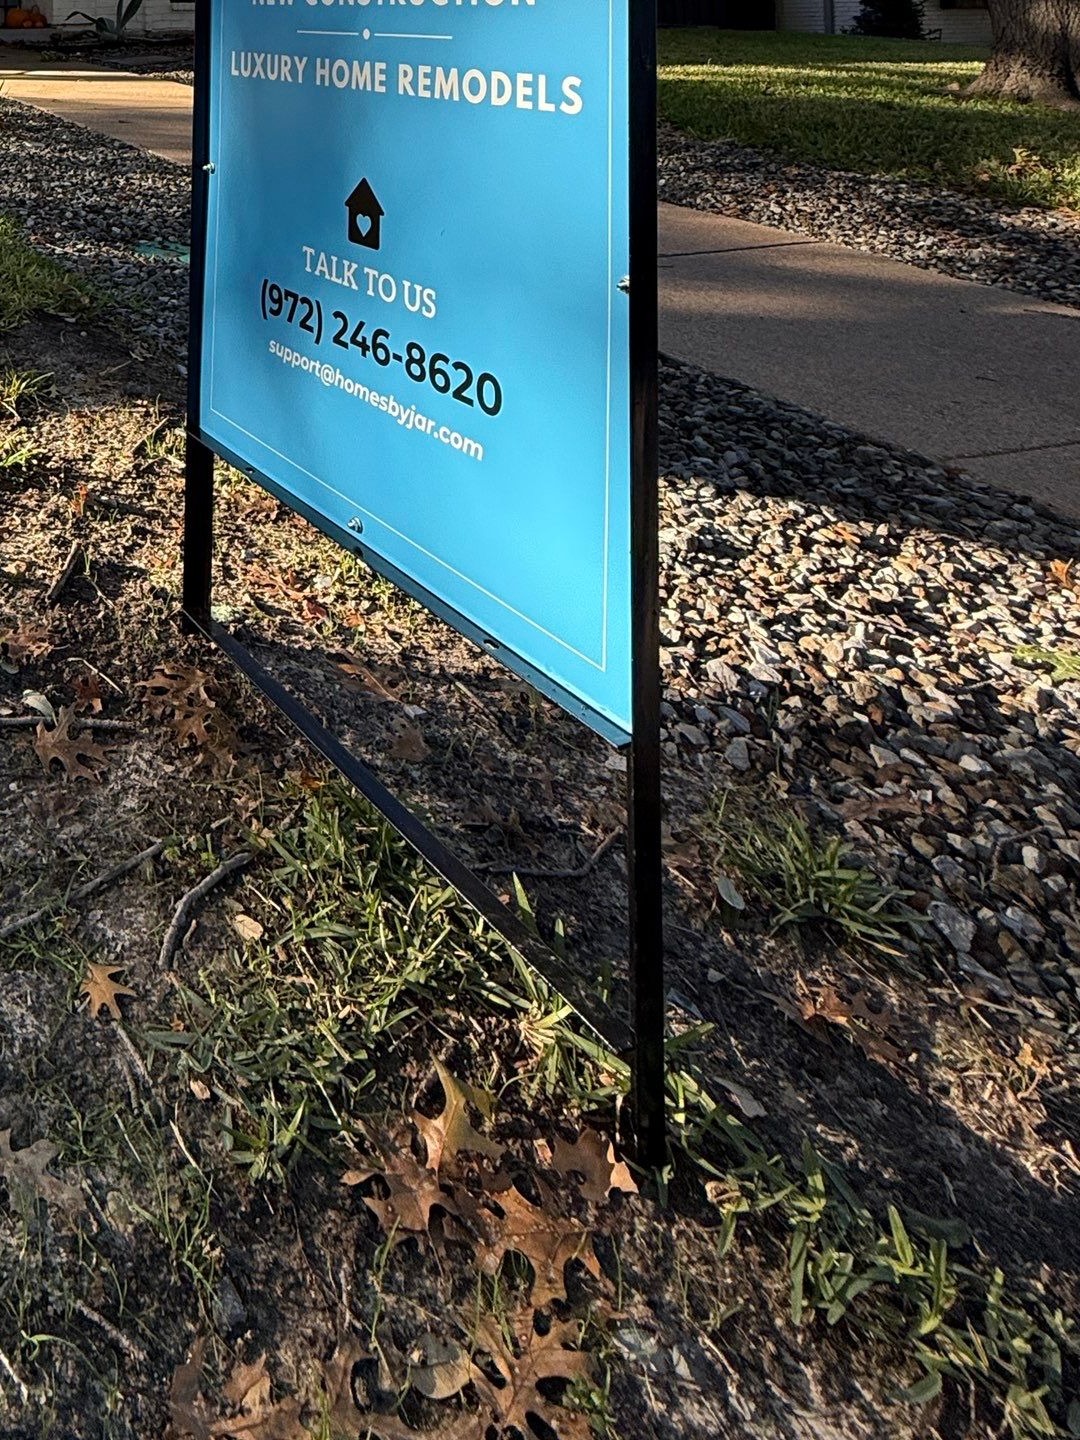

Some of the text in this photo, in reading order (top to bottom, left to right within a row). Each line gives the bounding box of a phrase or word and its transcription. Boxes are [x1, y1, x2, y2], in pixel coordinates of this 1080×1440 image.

[231, 51, 583, 115] LUXURY HOME REMODELS
[303, 246, 436, 319] TALK TO US
[261, 279, 502, 417] (972) 246-8620
[269, 340, 484, 461] support@homesbyjar.com
